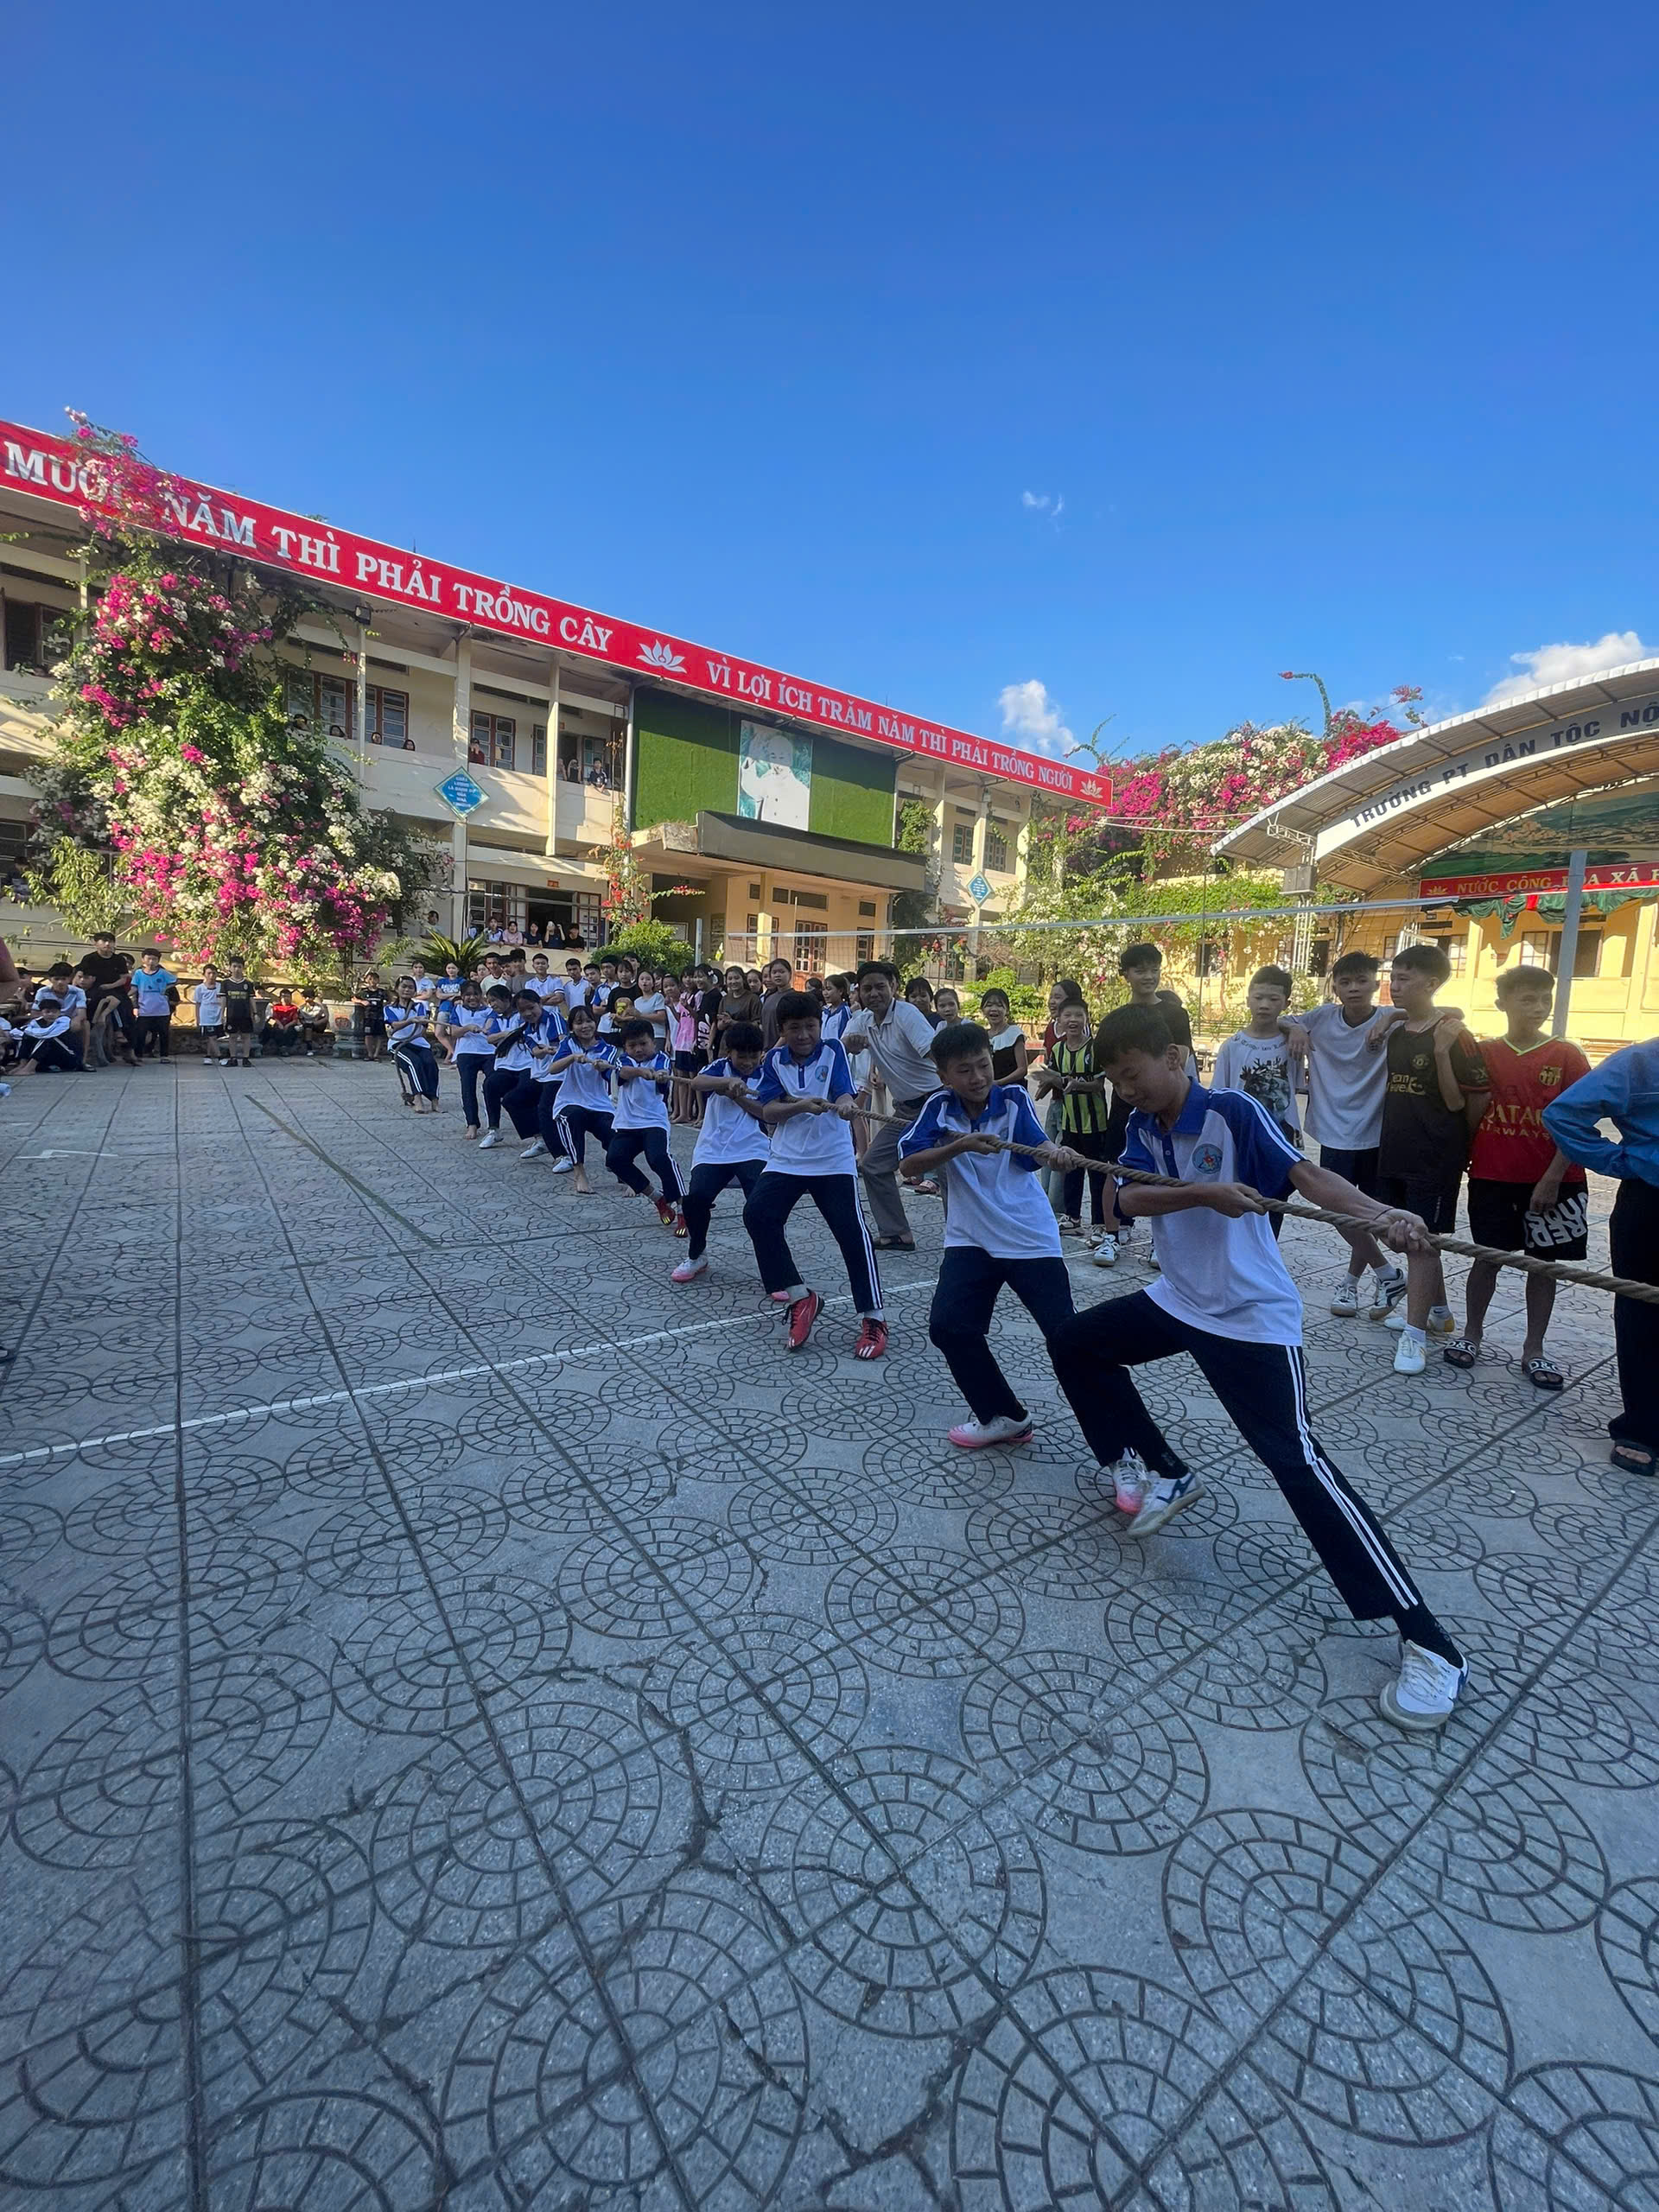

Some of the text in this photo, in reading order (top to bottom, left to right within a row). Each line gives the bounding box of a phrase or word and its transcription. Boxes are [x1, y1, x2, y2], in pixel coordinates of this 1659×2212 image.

[163, 491, 257, 549] NĂM
[270, 525, 340, 574] THÌ
[355, 552, 442, 603] PHẢI
[453, 582, 550, 635] TRỒNG
[560, 616, 613, 652] CÂY
[706, 658, 1072, 791] VÌ LỢI ÍCH TRĂM NĂM THÌ PHẢI TRỒNG NGƯỜI
[1351, 780, 1431, 827] TRƯỜNG
[1442, 763, 1468, 785] PT
[1484, 740, 1535, 768] DÂN
[1457, 878, 1499, 895] NƯỚC
[1611, 868, 1640, 883] XÃ
